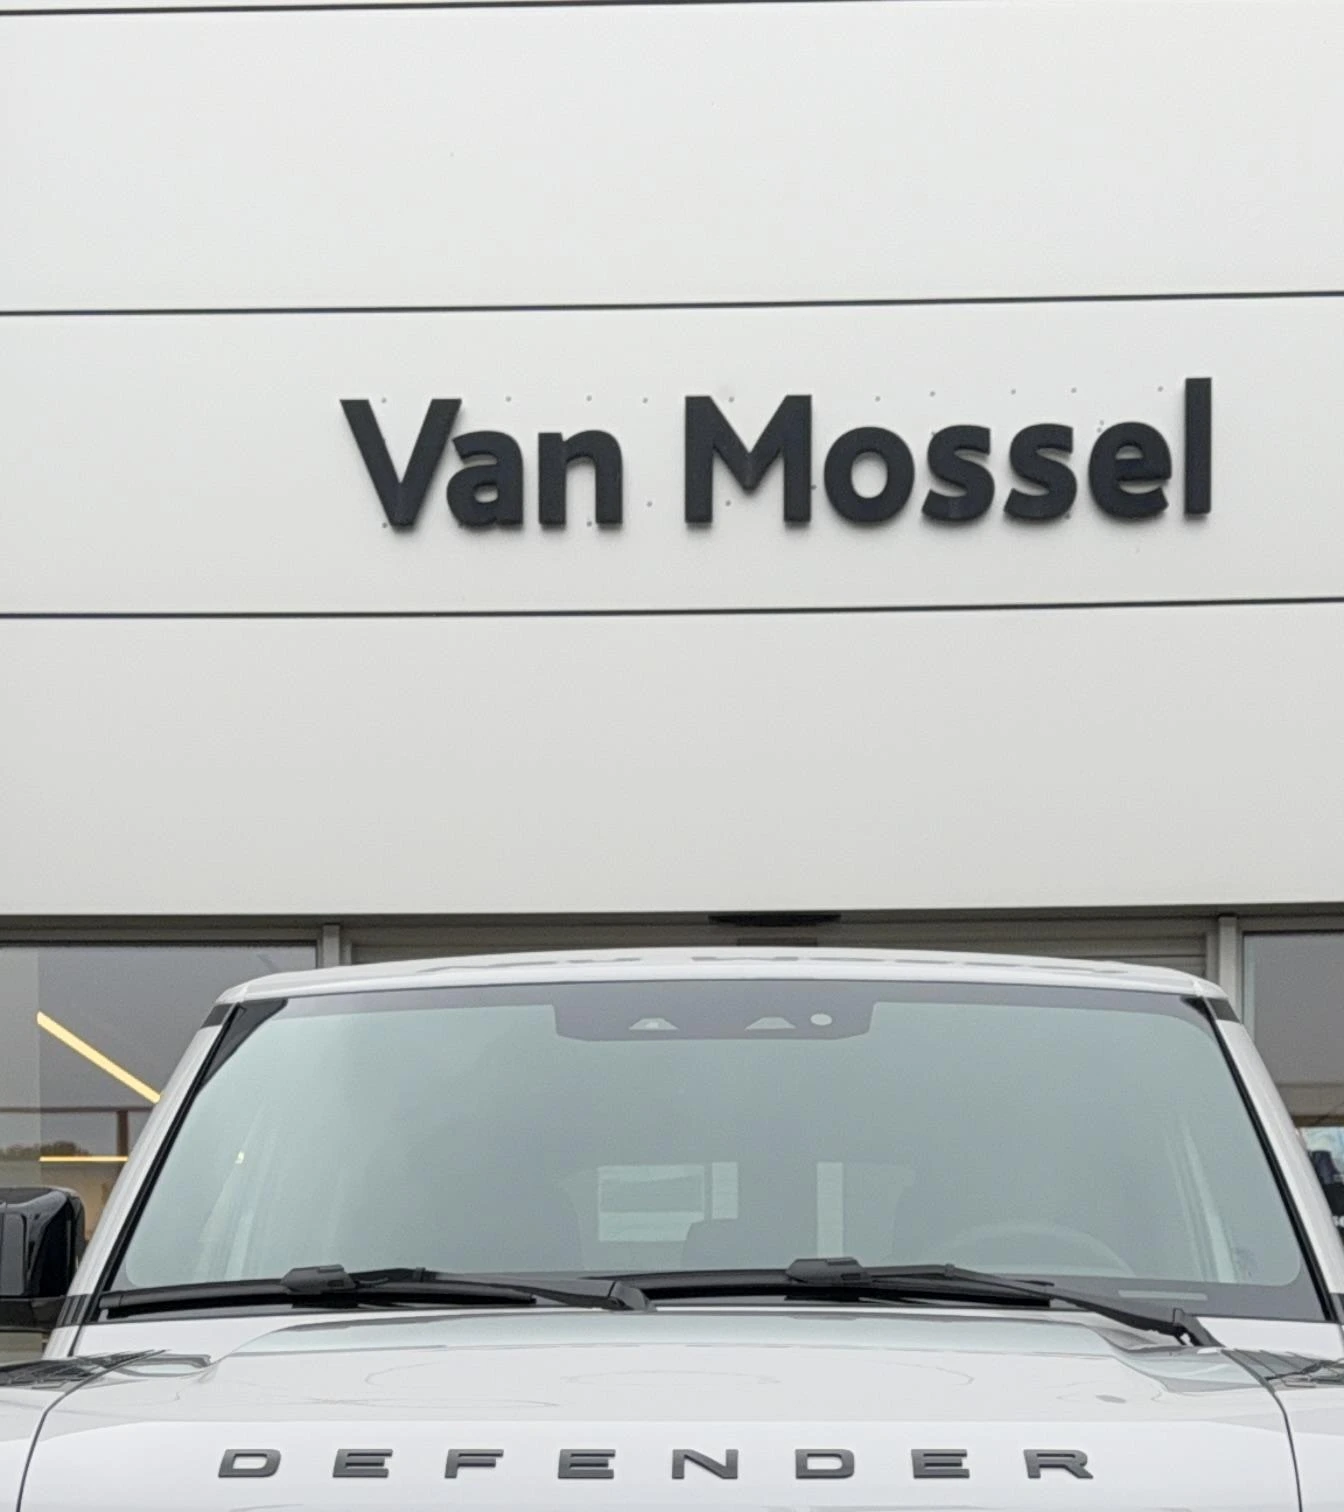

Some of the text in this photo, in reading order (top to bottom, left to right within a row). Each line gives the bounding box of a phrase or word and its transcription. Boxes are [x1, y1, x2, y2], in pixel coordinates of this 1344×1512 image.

[340, 377, 1213, 527] Van Mossel
[217, 1448, 1094, 1480] DEFENDER
